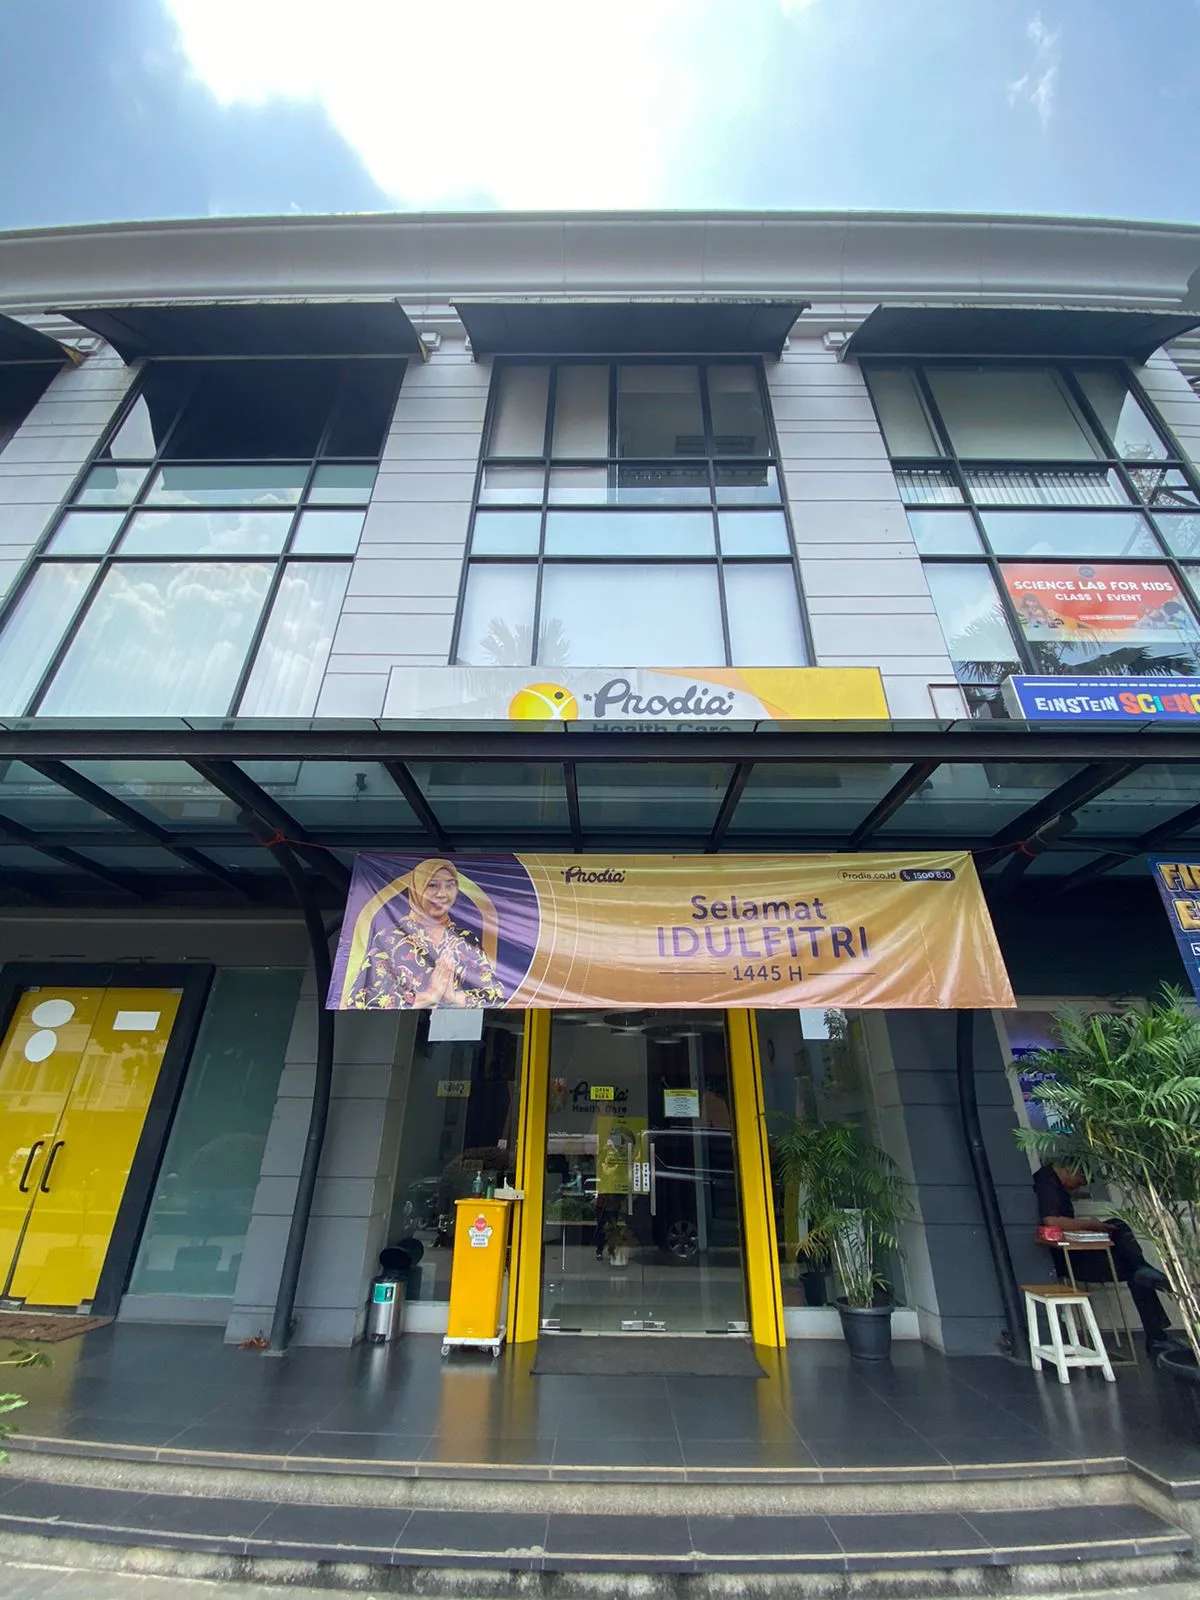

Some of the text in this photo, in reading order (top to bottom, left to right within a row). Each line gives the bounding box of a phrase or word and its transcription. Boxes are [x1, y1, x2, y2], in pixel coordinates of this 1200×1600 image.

[1013, 580, 1174, 592] SCIENCE LAB FOR KIDS
[1055, 593, 1142, 603] CLASS EVENT
[592, 678, 736, 718] Prodia
[1034, 695, 1119, 714] EINSTEIN
[560, 865, 627, 885] Prodia
[842, 871, 952, 881] Prodia.co.id 1500 830
[691, 894, 825, 921] Selamat
[656, 925, 871, 960] IDULFITRI
[732, 965, 803, 982] 1445 H
